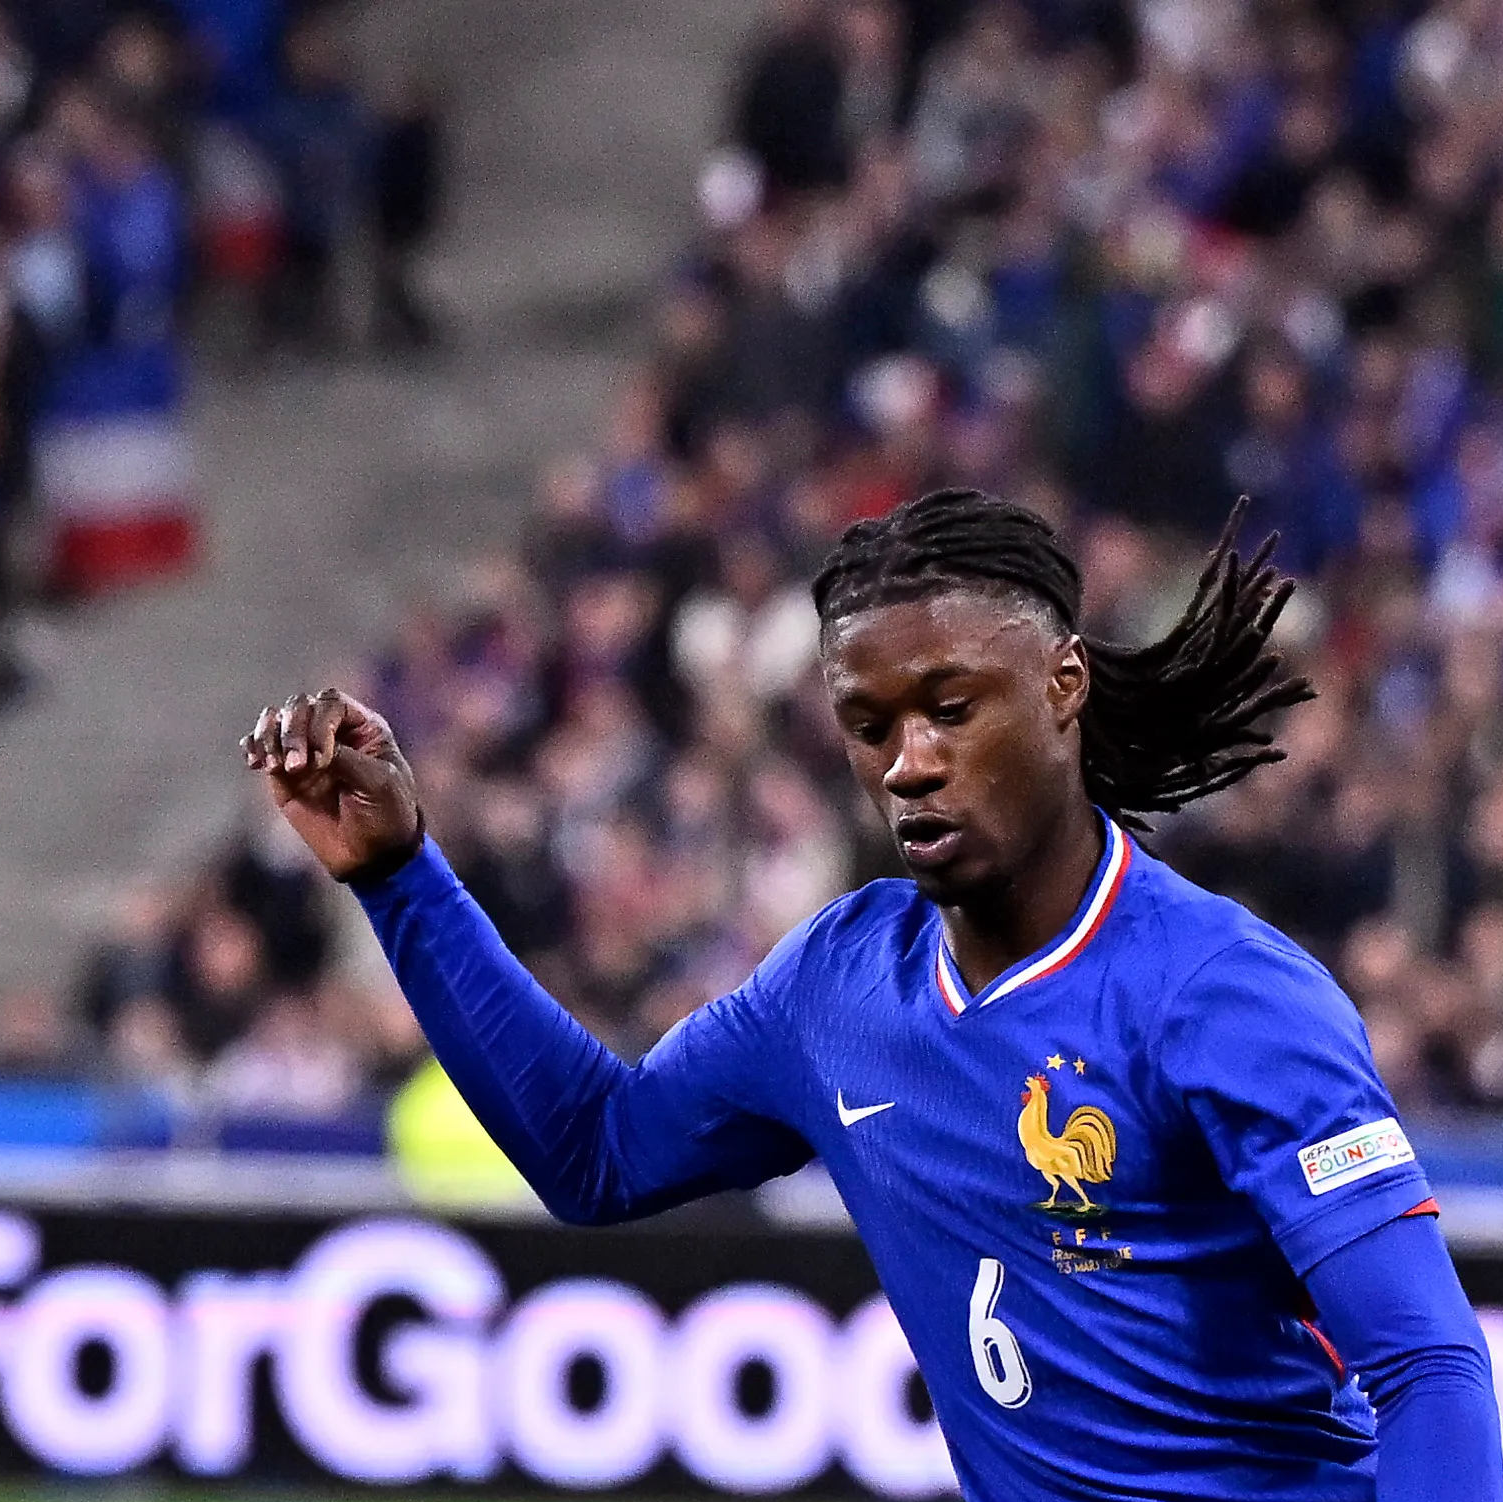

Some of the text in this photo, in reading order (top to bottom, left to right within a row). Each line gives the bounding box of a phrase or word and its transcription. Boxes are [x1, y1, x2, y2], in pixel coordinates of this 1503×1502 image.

[1303, 1144, 1331, 1162] UEFA
[1306, 1134, 1405, 1179] FOUNDATO
[969, 1258, 1032, 1409] 6
